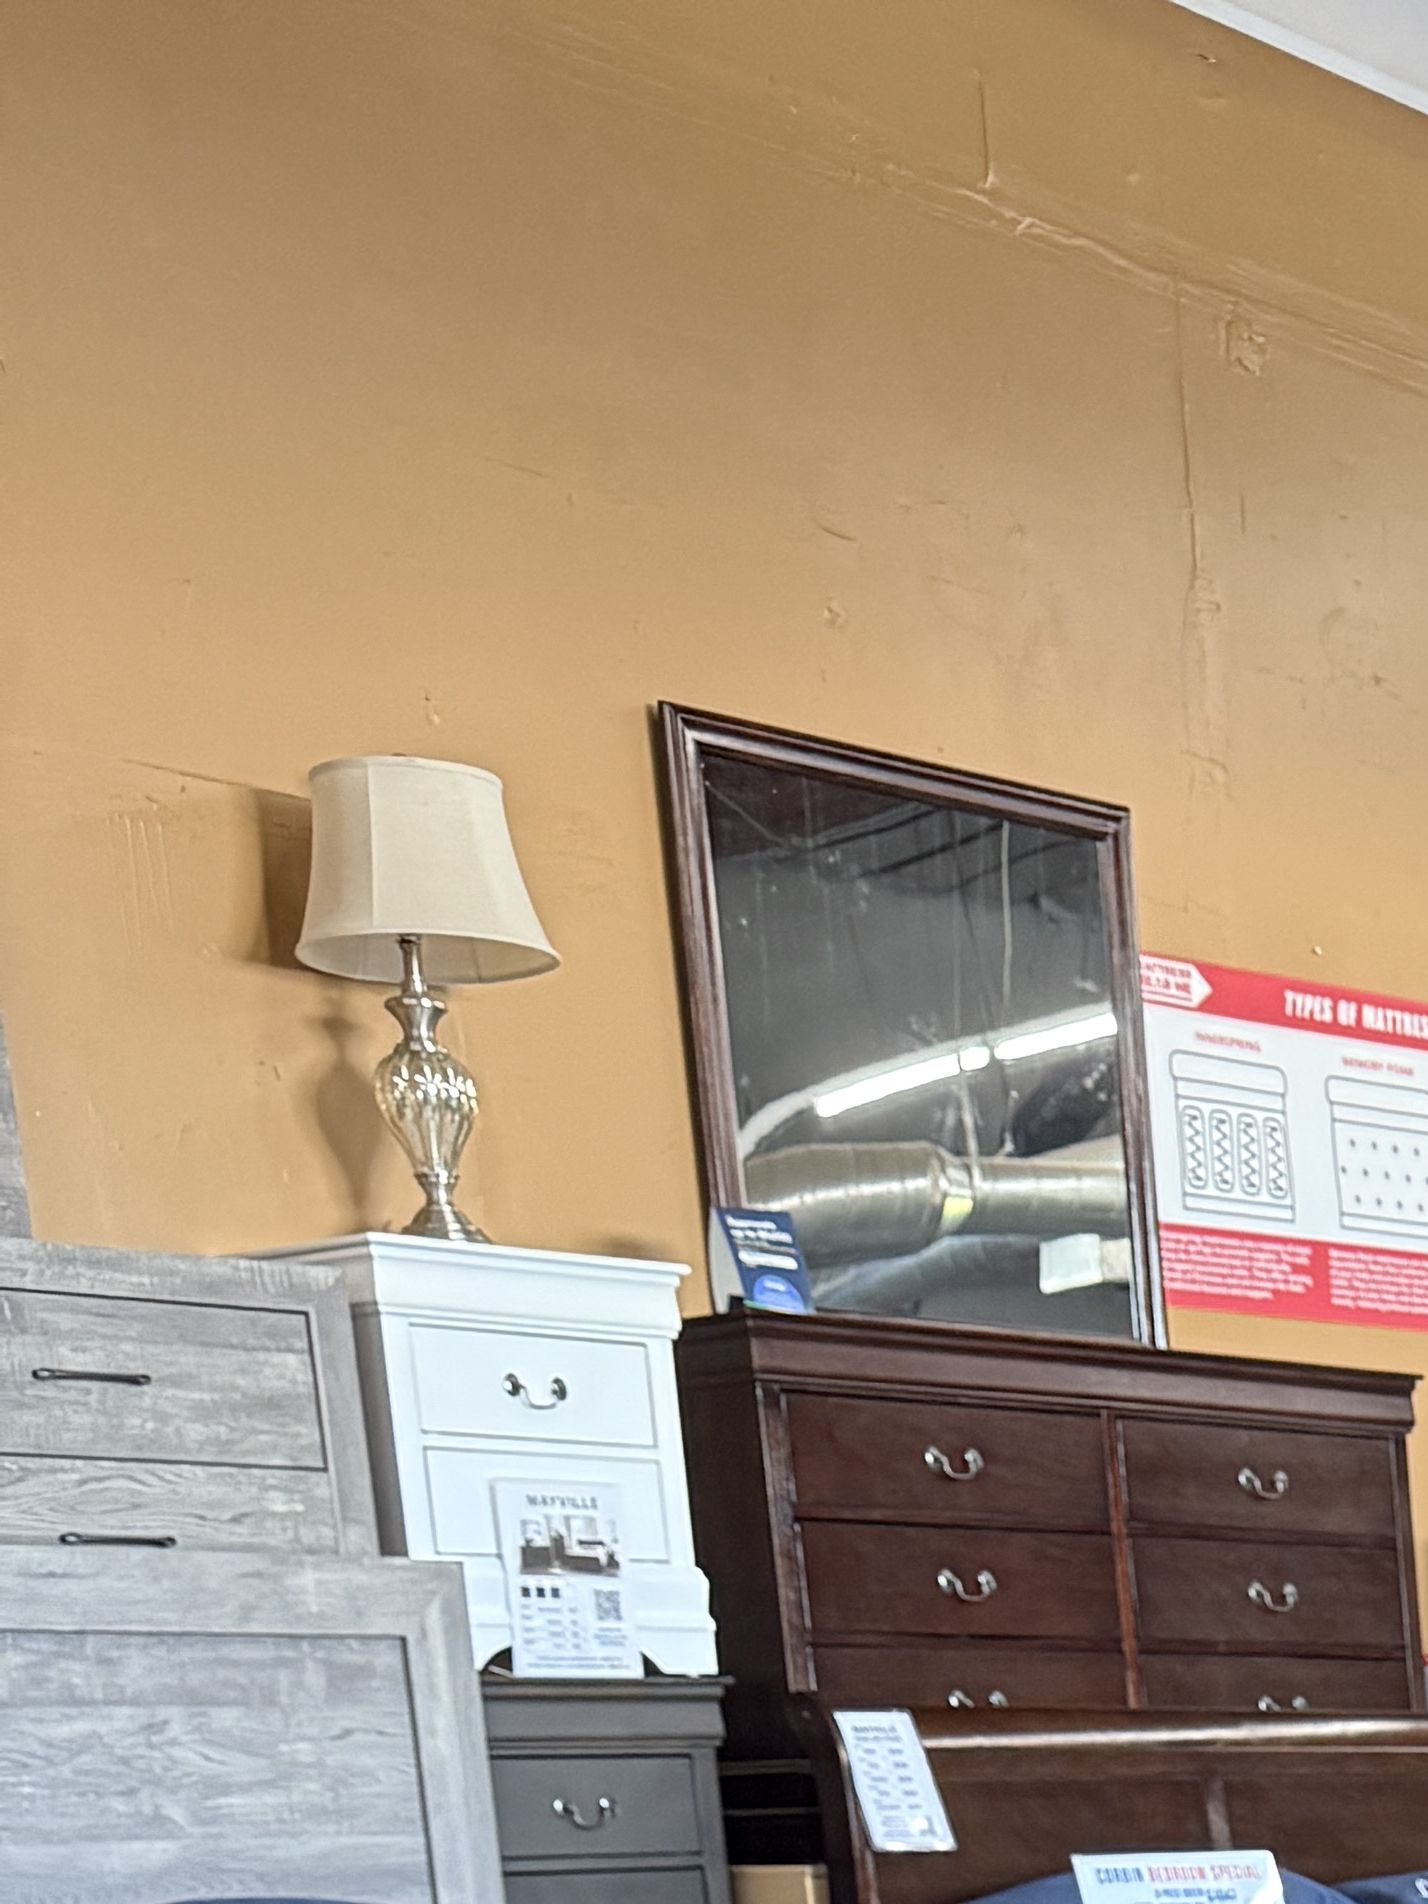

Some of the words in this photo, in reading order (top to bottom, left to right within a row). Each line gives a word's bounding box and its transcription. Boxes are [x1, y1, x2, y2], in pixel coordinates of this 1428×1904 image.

[1284, 989, 1333, 1024] TYPES
[1337, 999, 1358, 1028] OF
[1210, 1864, 1260, 1881] SPECIAL
